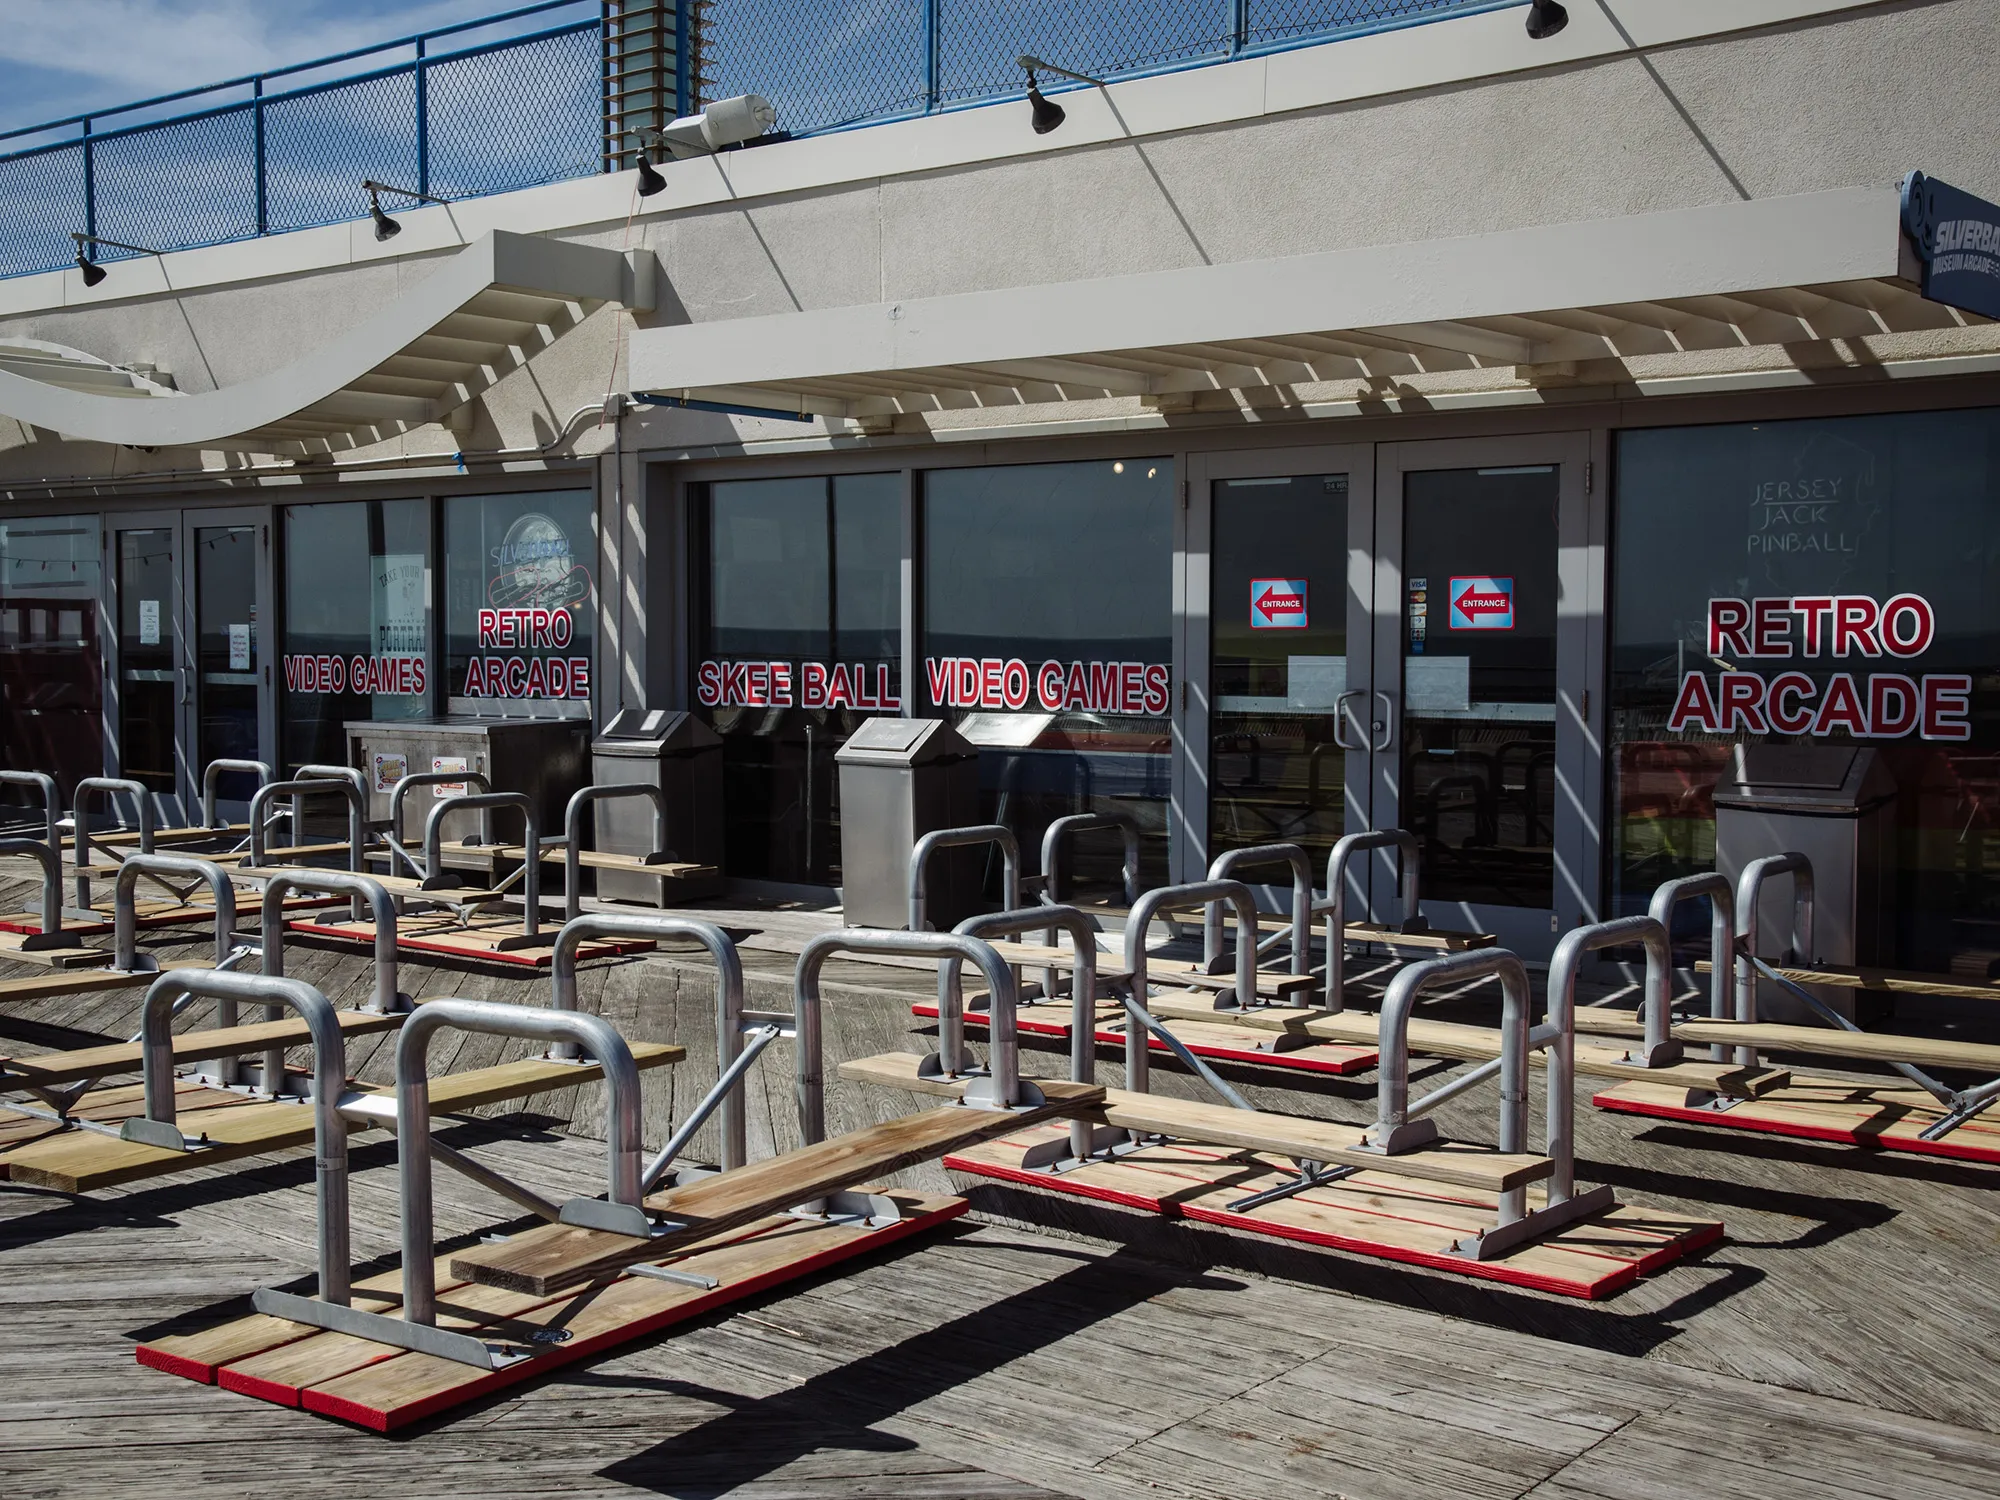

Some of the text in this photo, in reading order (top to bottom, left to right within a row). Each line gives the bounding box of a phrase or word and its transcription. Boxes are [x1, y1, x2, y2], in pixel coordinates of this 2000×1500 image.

[1934, 220, 2000, 257] SILVERBA
[1933, 254, 1991, 276] MUSEUM ARCADE
[1750, 477, 1842, 507] JERSEY
[1758, 505, 1828, 530] JACK
[1747, 532, 1854, 555] PINBALL
[379, 565, 420, 588] TAKE YOUR
[1262, 600, 1300, 608] ENTRANCE
[1462, 599, 1506, 607] ENTRANCE
[477, 607, 573, 650] RETRO
[1707, 593, 1935, 658] RETRO
[284, 654, 426, 695] VIDEO GAMES
[464, 656, 590, 699] ARCADE
[698, 660, 901, 711] SKEE BALL
[925, 657, 1170, 715] VIDEO GAMES
[1667, 671, 1972, 741] ARCADE
